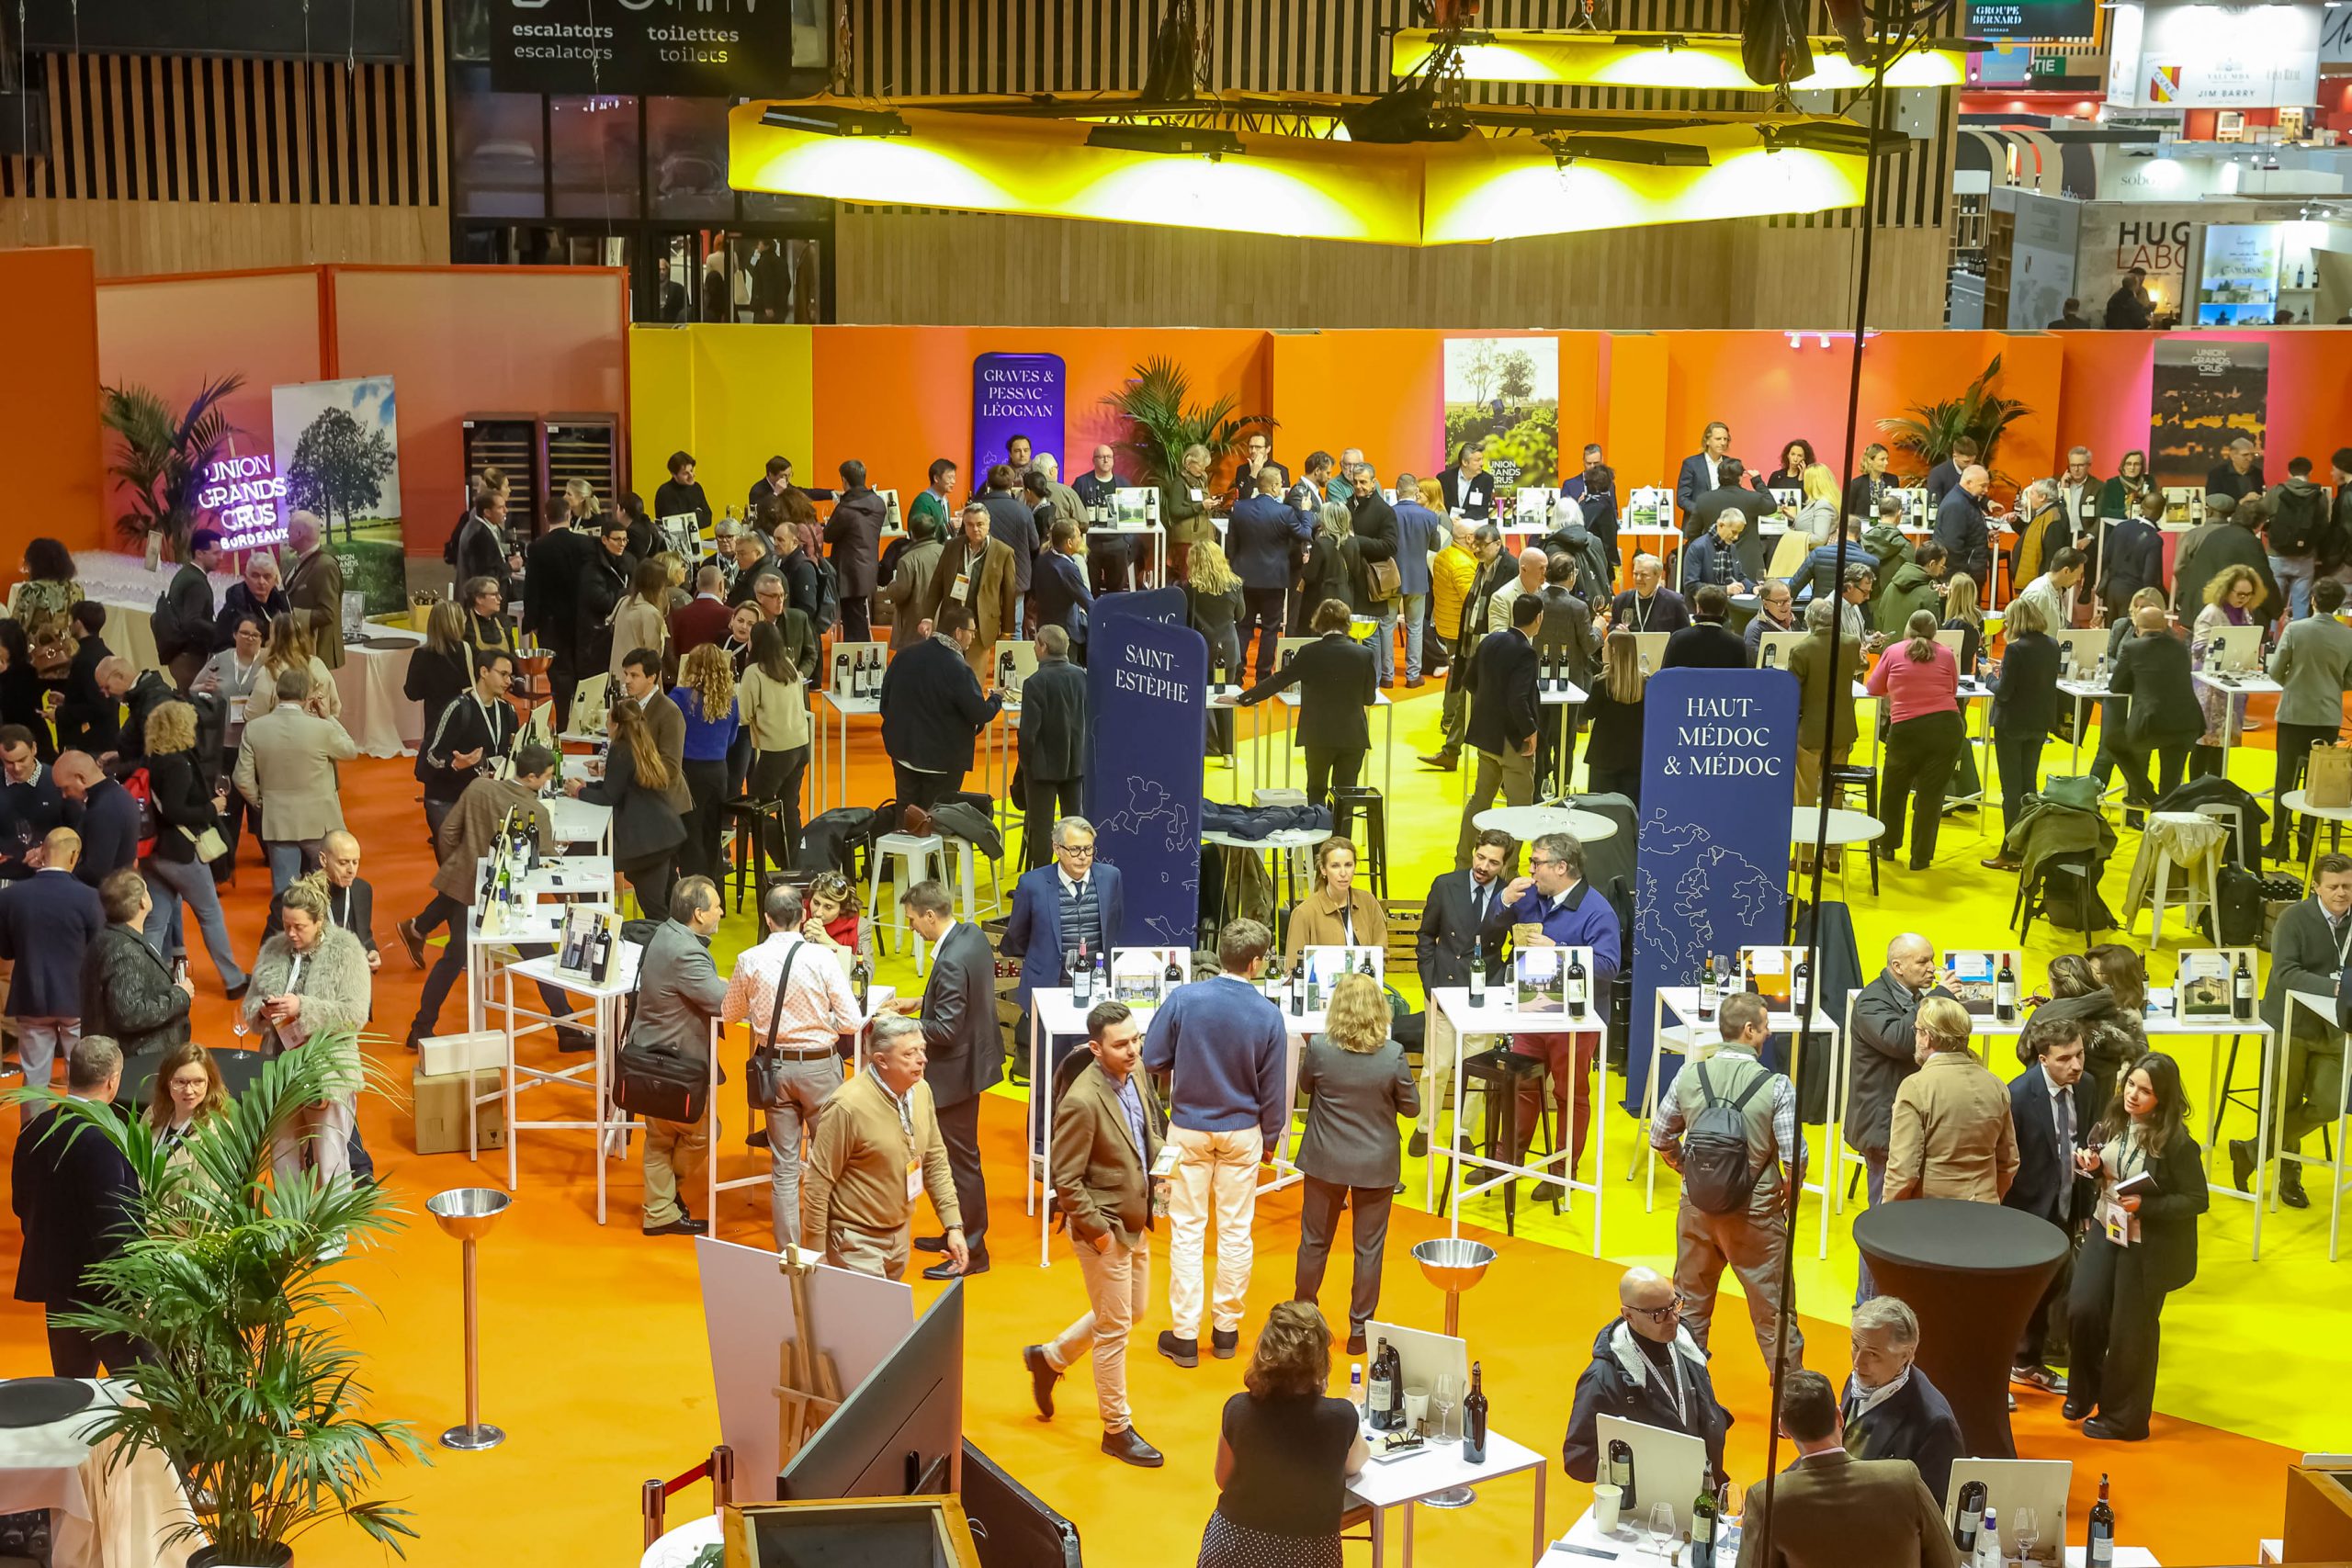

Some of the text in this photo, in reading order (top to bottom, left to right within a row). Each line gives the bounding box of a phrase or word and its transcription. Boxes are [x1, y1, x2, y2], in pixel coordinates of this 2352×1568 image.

[1975, 6, 2019, 16] GROUPE
[1972, 15, 2022, 25] BERNARD
[512, 23, 614, 39] escalators
[647, 26, 739, 43] toilettes
[514, 44, 613, 60] escalators
[660, 48, 729, 64] toilets
[2030, 59, 2055, 73] TIE
[2222, 89, 2256, 97] BARRY
[2197, 348, 2226, 356] UNION
[2191, 356, 2231, 365] GRANDS
[984, 369, 1054, 382] GRAVES &
[989, 387, 1049, 400] PESSAC-
[983, 400, 1053, 417] LÉOGNAN
[205, 455, 271, 482] UNION
[1488, 460, 1516, 468] UNION
[198, 477, 288, 508] GRANDS
[221, 503, 277, 531] CRUS
[220, 528, 289, 549] BORDEAUX
[340, 559, 359, 568] ANDS
[1125, 644, 1181, 671] SAINT-
[1115, 669, 1189, 704] ESTÈPHE
[1687, 697, 1762, 717] HAUT-
[1678, 722, 1770, 747] MÉDOC
[1664, 751, 1781, 776] & MÉDOC
